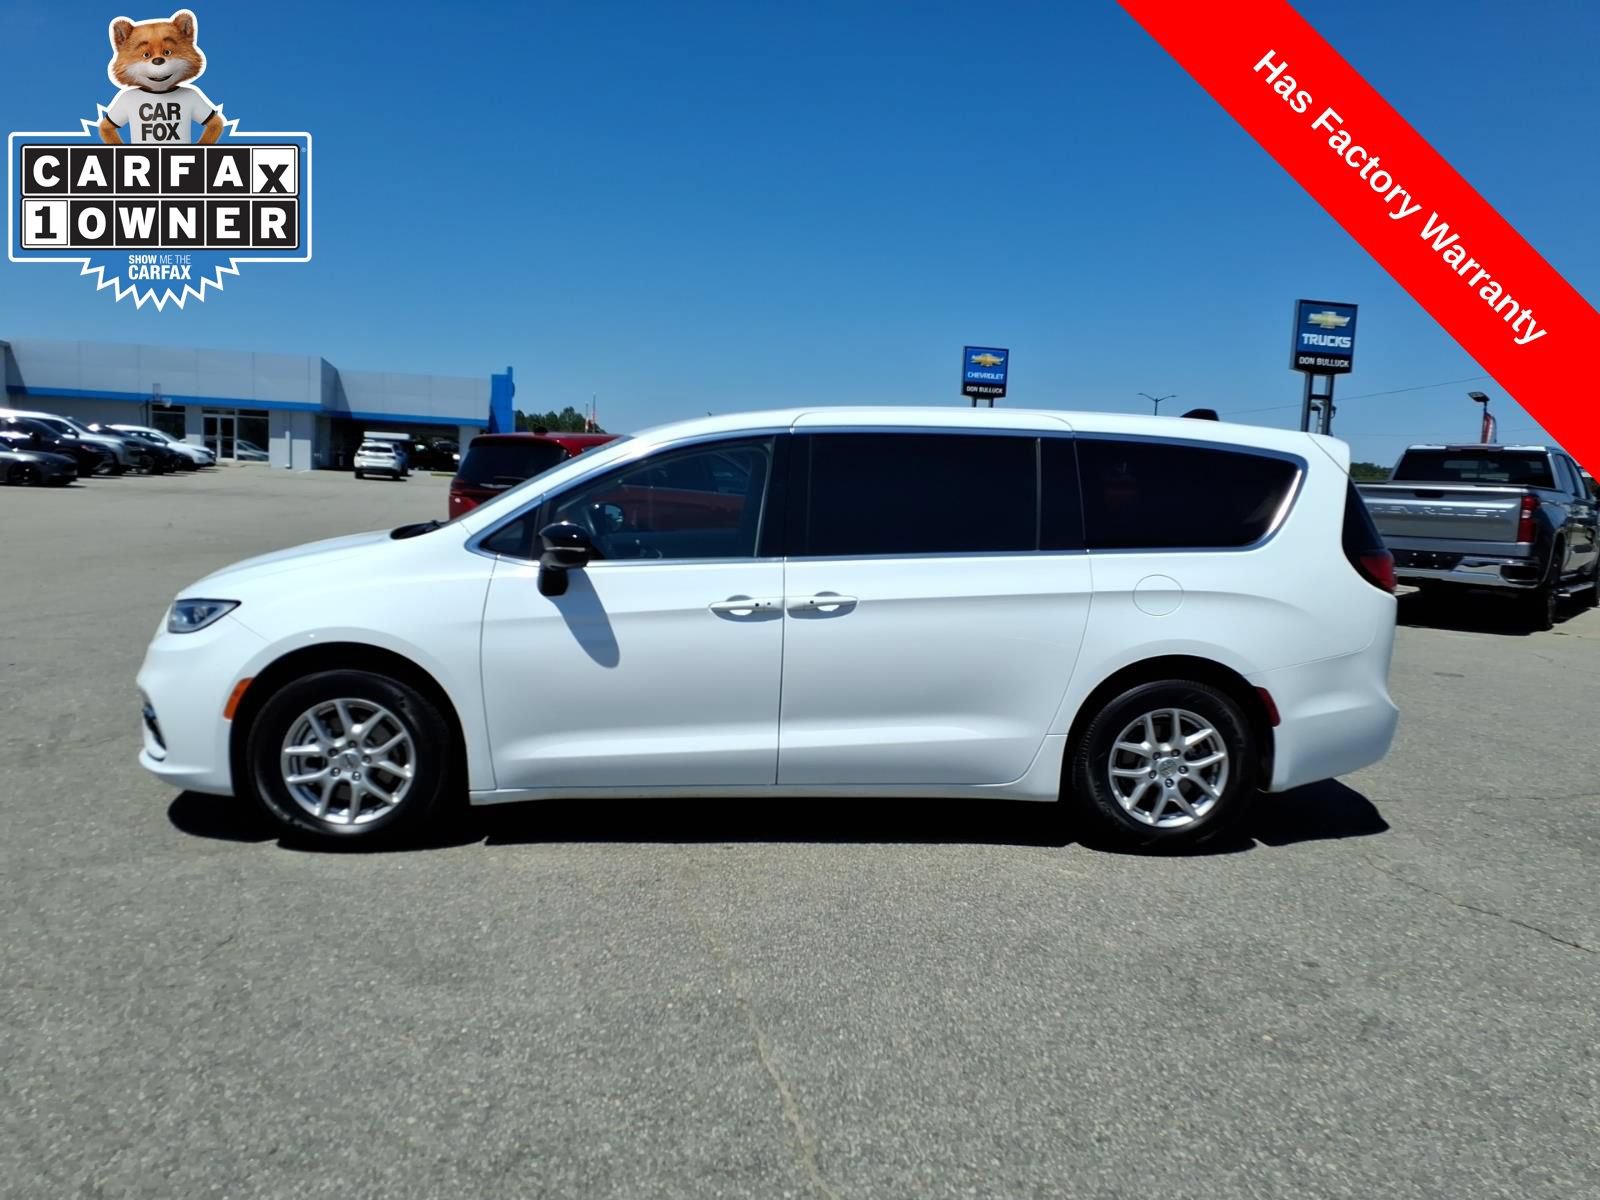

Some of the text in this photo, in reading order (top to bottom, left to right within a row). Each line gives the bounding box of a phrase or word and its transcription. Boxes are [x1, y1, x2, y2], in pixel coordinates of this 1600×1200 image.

[1302, 333, 1352, 348] TRUCKS
[1298, 356, 1350, 368] DON BULLUCK
[967, 371, 1004, 380] CHEVROLET
